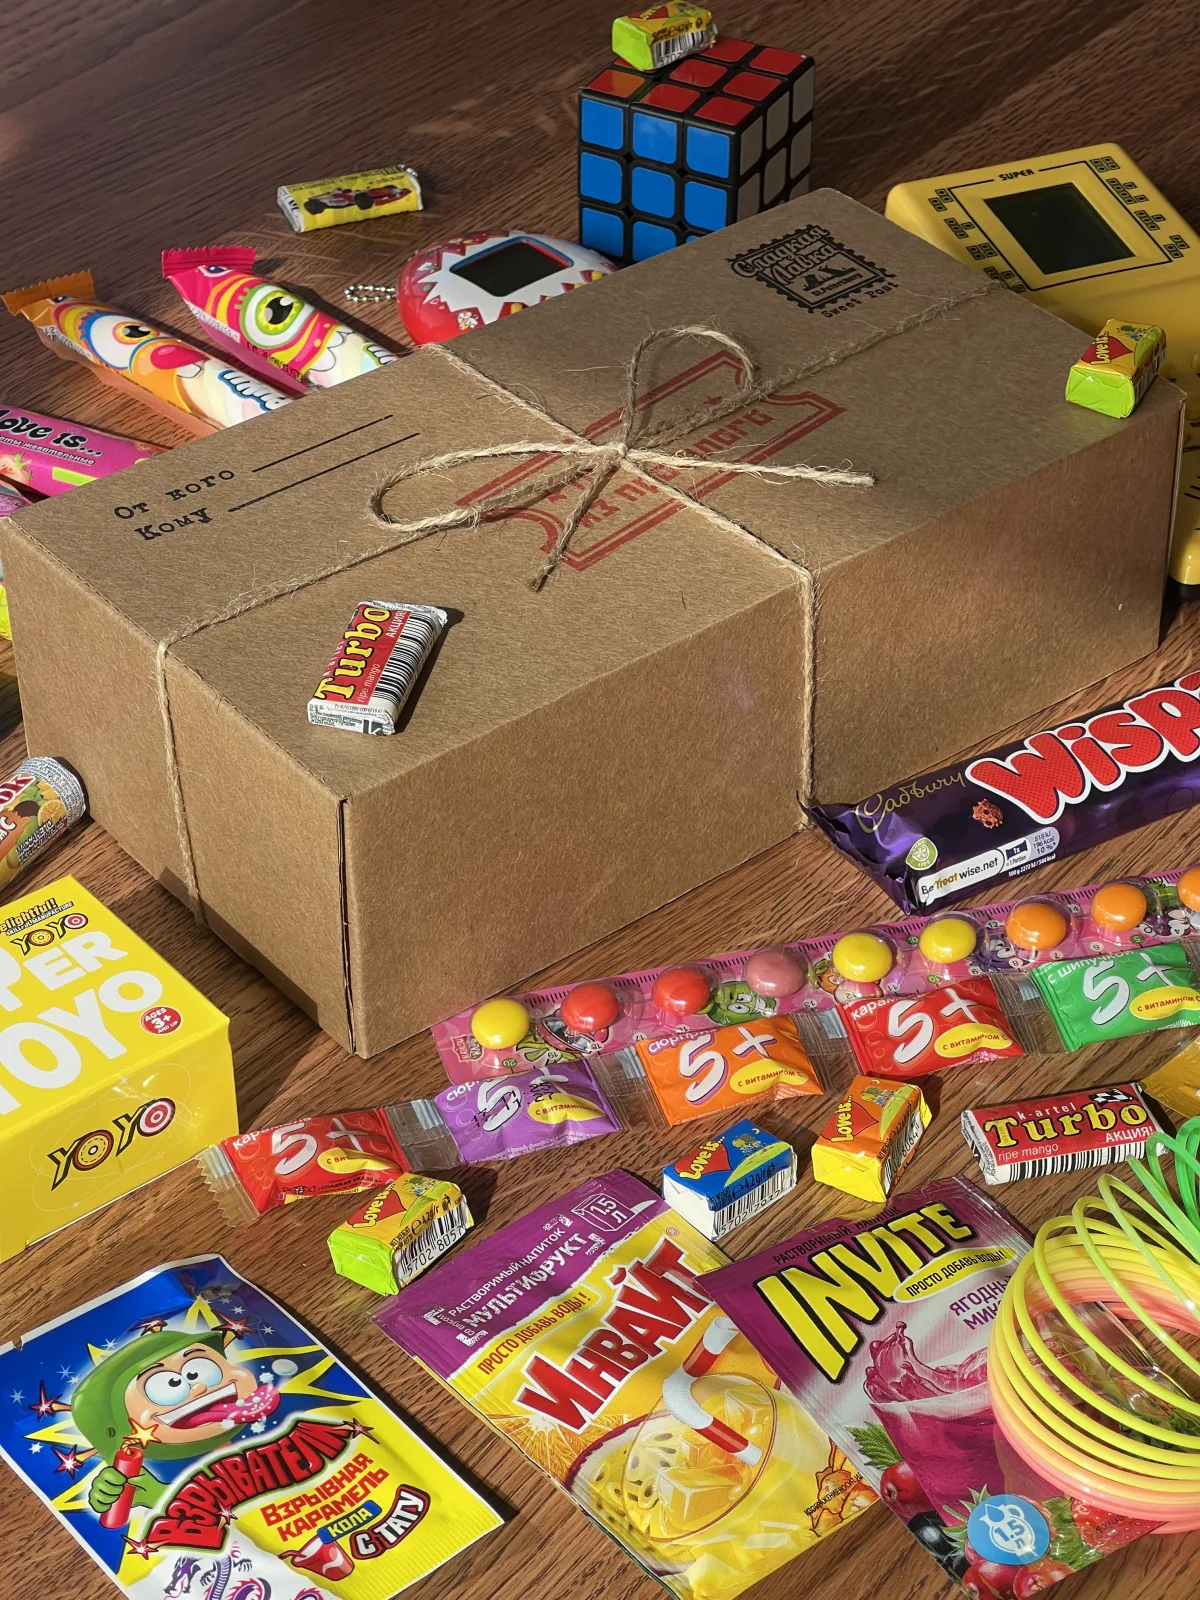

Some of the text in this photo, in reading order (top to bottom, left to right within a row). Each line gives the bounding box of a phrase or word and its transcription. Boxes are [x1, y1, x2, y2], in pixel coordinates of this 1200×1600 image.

[998, 169, 1035, 182] SUPER
[731, 224, 831, 278] Сладкая
[770, 245, 839, 286] Лавка
[821, 281, 899, 318] Sweet Post
[113, 469, 235, 520] От кого
[134, 507, 214, 541] Кому
[313, 606, 392, 701] Turbo
[357, 663, 381, 703] ripe mango
[965, 671, 1200, 825] Wisp
[854, 771, 967, 834] Cadbury
[935, 872, 958, 889] Treat
[959, 856, 999, 881] wise.net
[1083, 952, 1174, 1025] 5+
[1144, 996, 1195, 1011] витамином
[144, 1006, 167, 1022] AGES
[151, 1013, 172, 1031] 3+
[888, 988, 978, 1064] 5+
[679, 1026, 778, 1105] 5+
[831, 1115, 854, 1142] Love
[983, 1102, 1150, 1149] Turbo
[1017, 1102, 1077, 1119] k-artel
[47, 1097, 176, 1192] YOYO
[272, 1117, 368, 1177] 5+
[998, 1142, 1060, 1163] ripe mango
[1105, 1125, 1154, 1144] АКЦИЯ!
[680, 1147, 712, 1180] Love
[353, 1198, 384, 1229] Love
[590, 1197, 618, 1222] 1.5
[406, 1247, 434, 1277] 5702
[772, 1222, 853, 1265] РАСТВОРИМЫЙ
[448, 1226, 567, 1317] РАСТВОРИМЫЙ НАПИТОК
[462, 1232, 589, 1328] МУЛЬТИФРУКТ
[905, 1249, 1007, 1298] ПРОСТО ДОБАВЬ ВОДЫ!
[753, 1202, 977, 1385] INVITE
[963, 1299, 1003, 1331] МИК
[477, 1339, 520, 1376] ПРОСТО
[515, 1312, 558, 1345] ДОБАВЬ
[554, 1296, 582, 1320] ВОДЫ
[277, 1467, 389, 1542] КАРАМЕЛЬ
[328, 1506, 373, 1538] КОЛА
[355, 1490, 425, 1558] С ТАТУ
[995, 1520, 1026, 1543] 1.5
